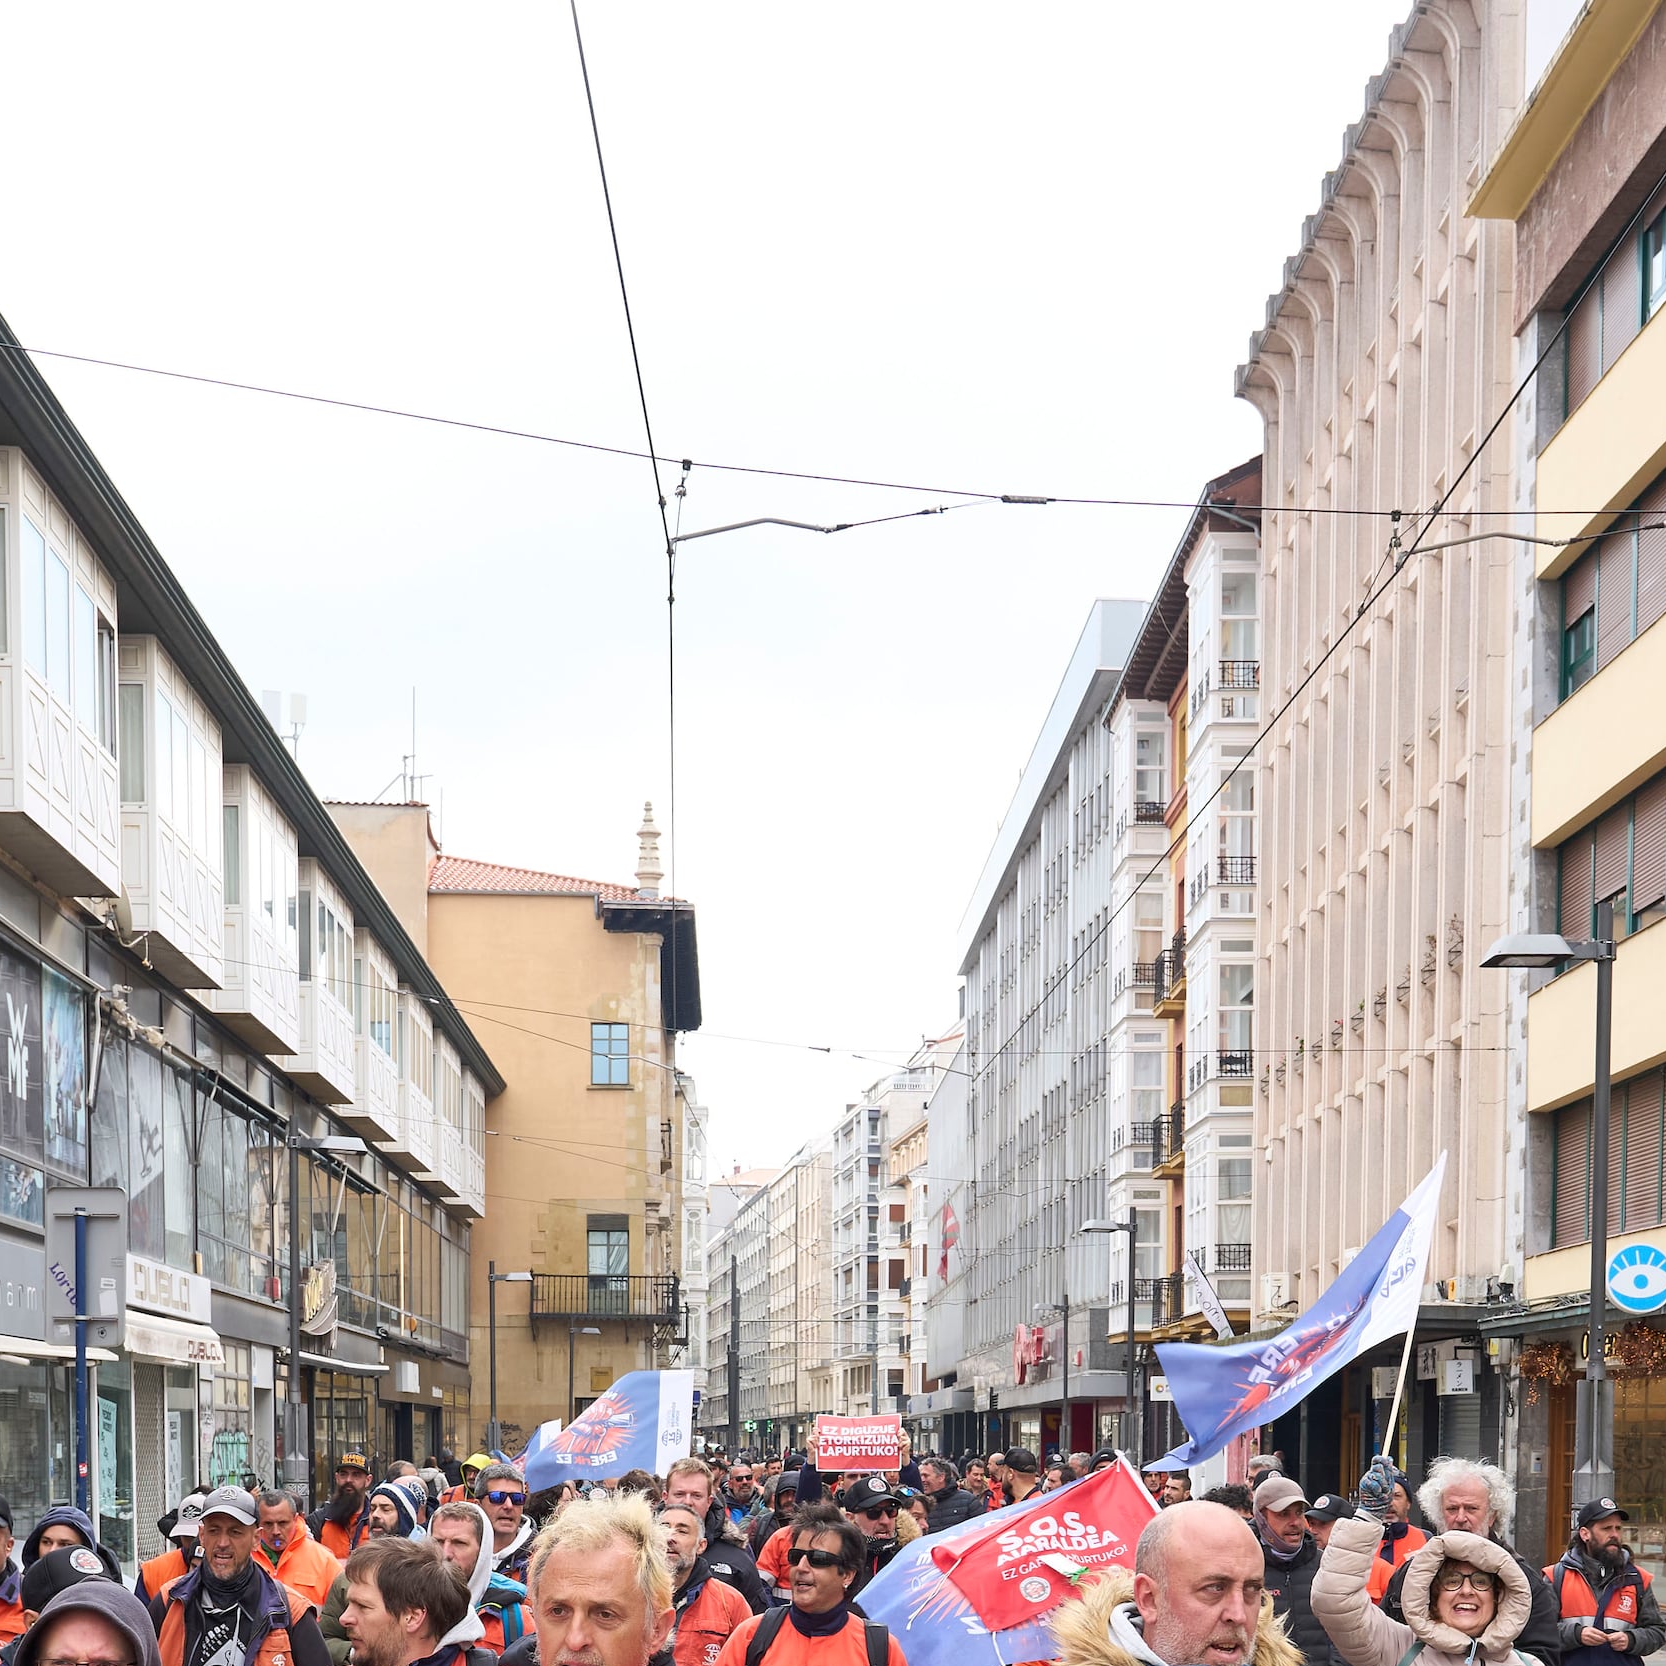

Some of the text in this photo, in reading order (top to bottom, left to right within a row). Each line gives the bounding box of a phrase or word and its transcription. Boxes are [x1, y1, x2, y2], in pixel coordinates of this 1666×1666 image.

[822, 1424, 897, 1436] EZ DIGUZUE
[819, 1434, 900, 1446] ETORKIZUNA
[819, 1445, 899, 1457] LAPURTUKO!
[996, 1511, 1097, 1553] S.O.S.
[996, 1529, 1120, 1567] AIARALDEA
[1001, 1568, 1018, 1581] EZ
